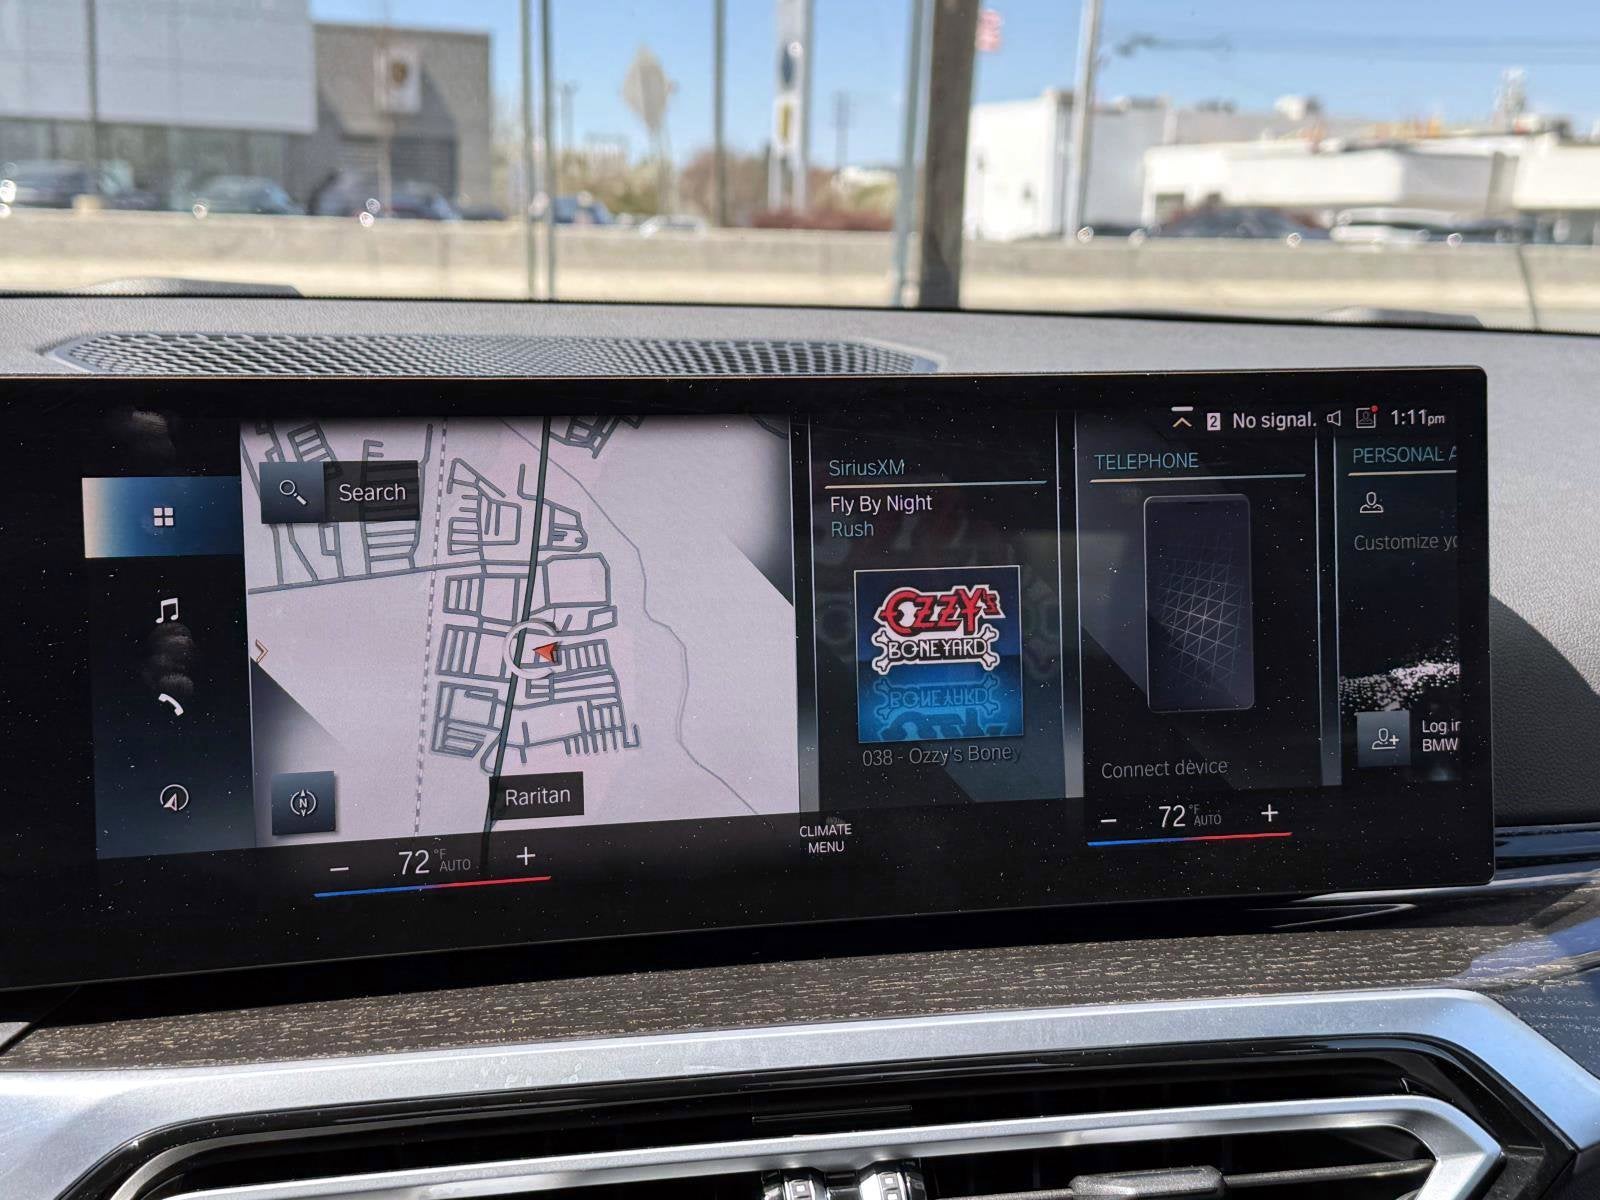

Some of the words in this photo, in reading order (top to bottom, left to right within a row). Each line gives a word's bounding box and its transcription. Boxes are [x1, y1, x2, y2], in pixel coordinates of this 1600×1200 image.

[1233, 412, 1256, 429] No
[1261, 411, 1317, 430] signal.
[1391, 409, 1445, 426] 1:11pm
[1094, 452, 1200, 471] TELEPHONE
[1353, 446, 1445, 464] PERSONAL
[828, 458, 906, 477] SiriusXM
[339, 482, 407, 502] Search
[830, 496, 855, 516] Fly
[859, 495, 882, 516] By
[886, 493, 933, 515] Night
[831, 521, 875, 538] Rush
[1354, 533, 1439, 551] Customize
[888, 637, 989, 660] BONEYARD
[1422, 719, 1447, 735] Log
[1422, 737, 1459, 752] BMW
[862, 748, 894, 767] 038
[909, 747, 963, 767] Ozzy's
[1101, 761, 1171, 779] Connect
[1175, 759, 1229, 777] device
[299, 798, 308, 809] N
[505, 786, 571, 806] Raritan
[1158, 804, 1187, 828] 72
[1193, 813, 1222, 827] AUTO
[799, 823, 853, 838] CLIMATE
[808, 840, 845, 854] MENU
[398, 849, 430, 875] 72
[439, 858, 471, 872] AUTO
